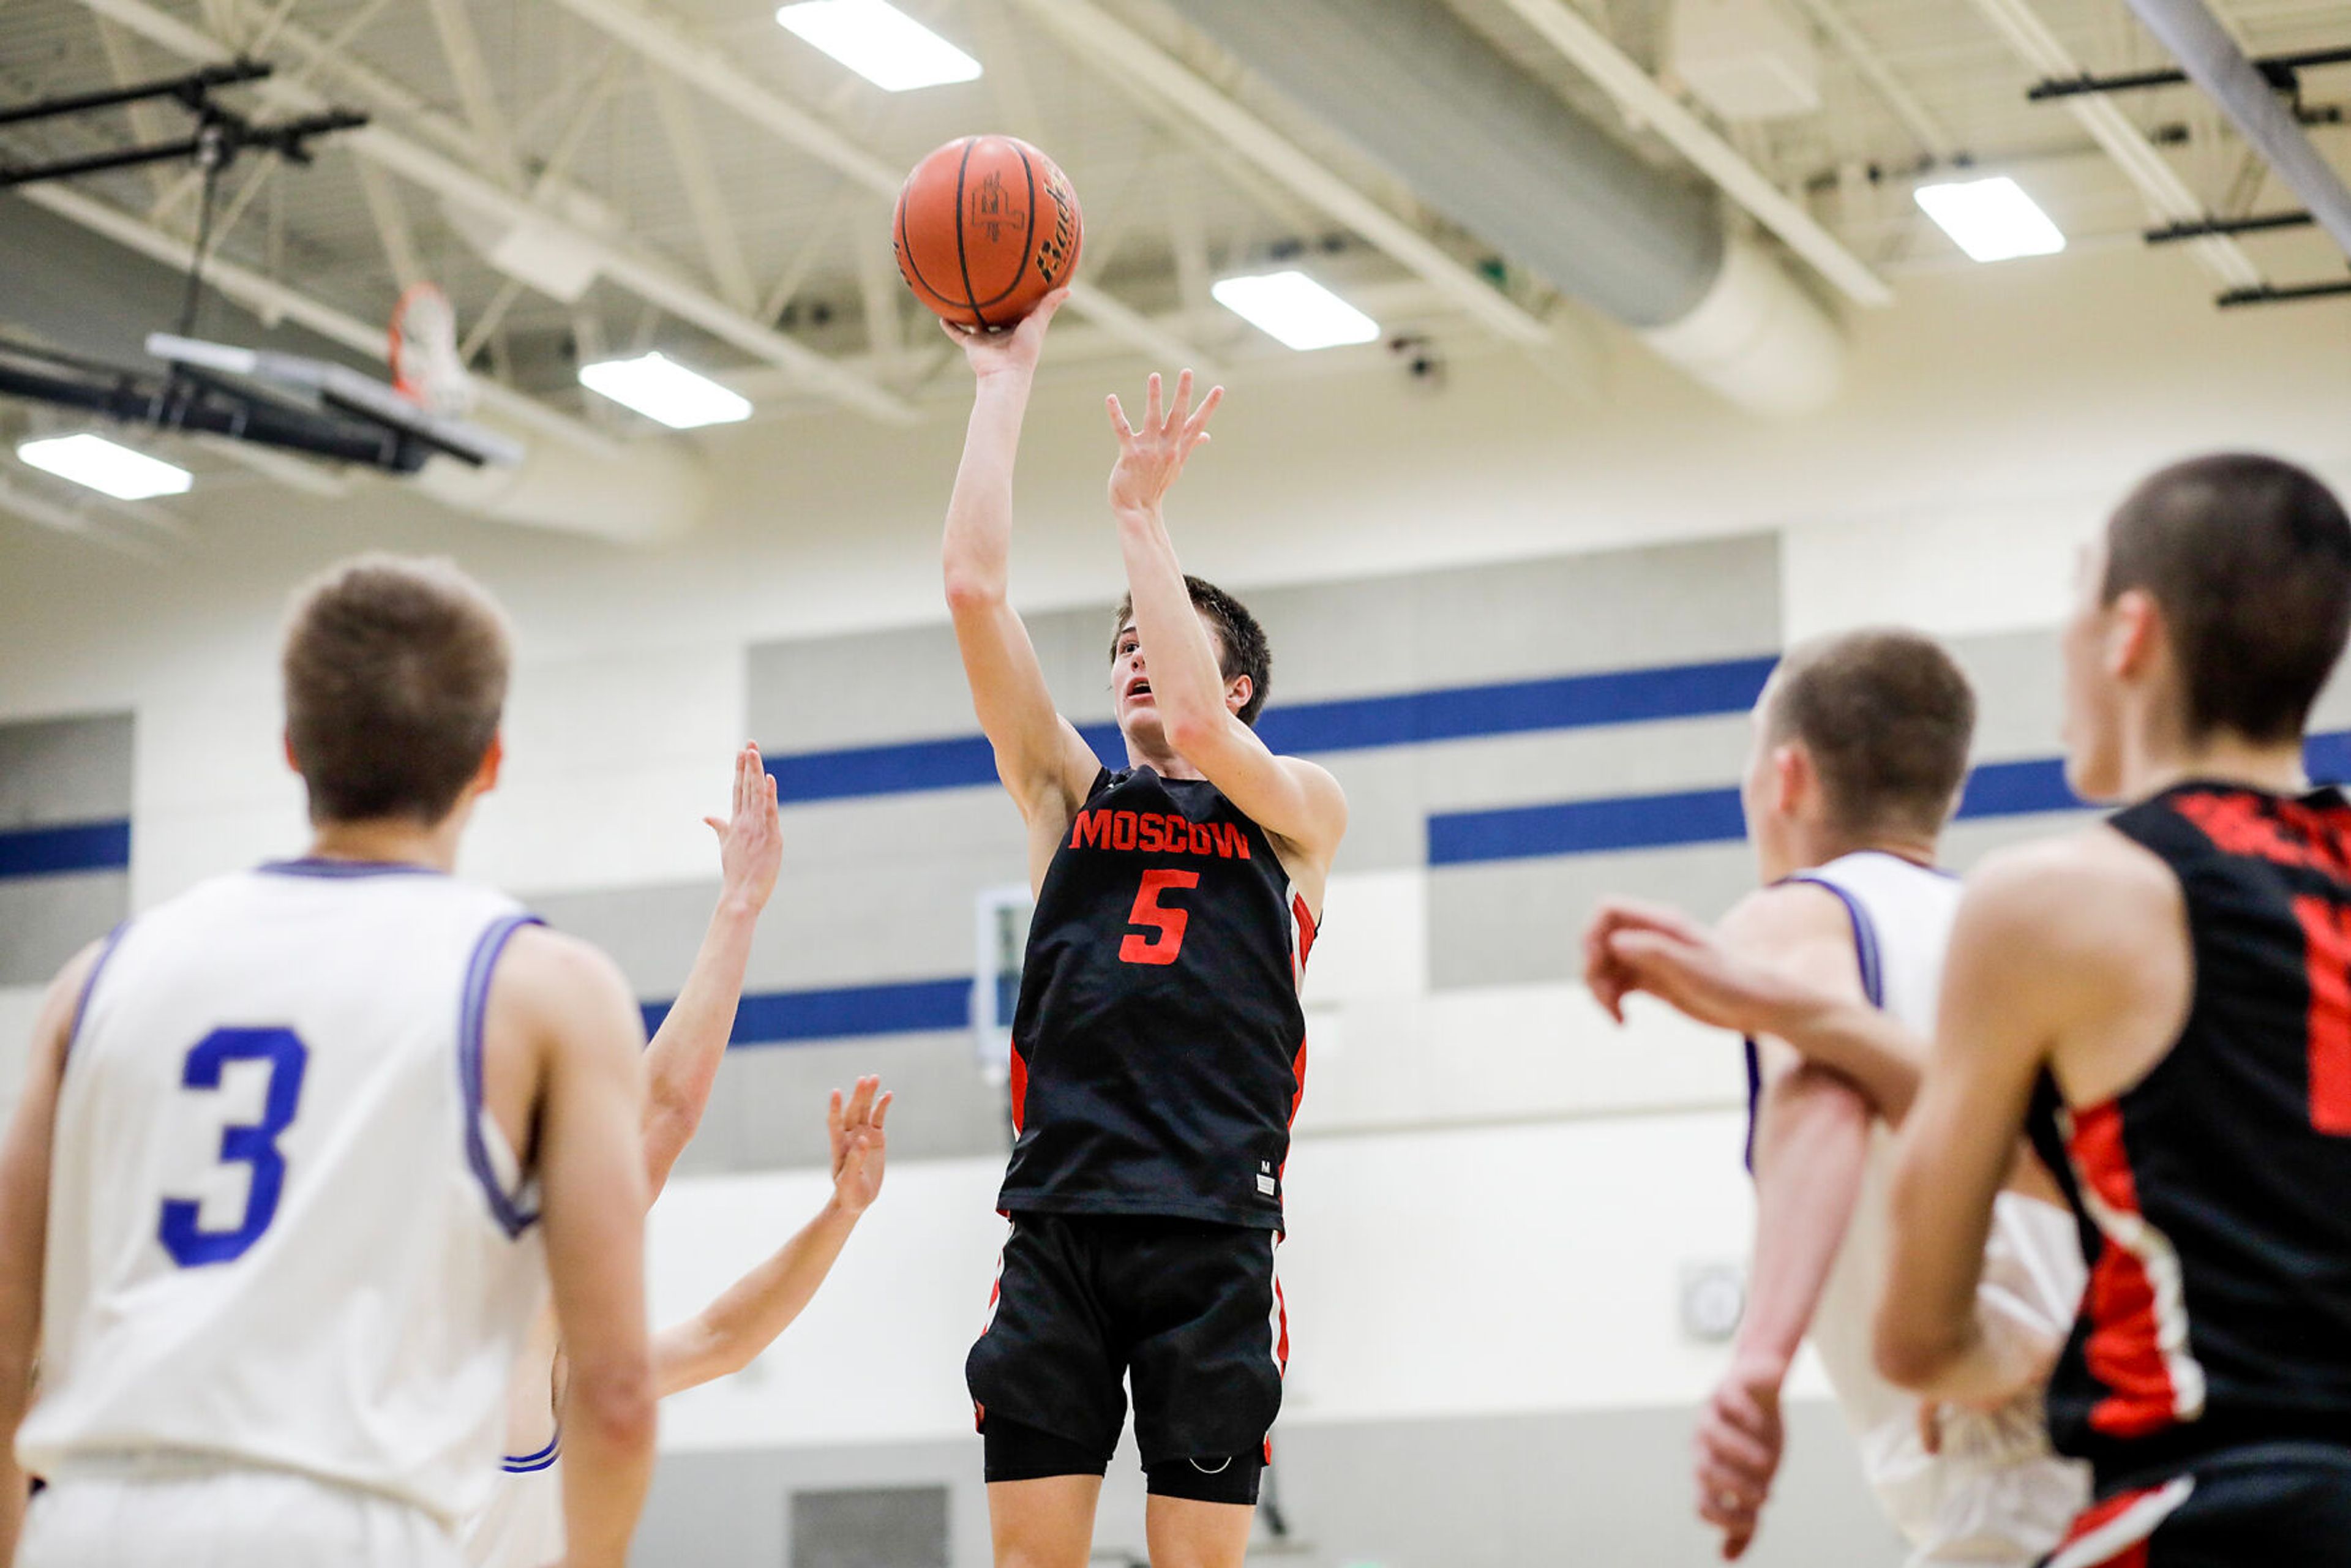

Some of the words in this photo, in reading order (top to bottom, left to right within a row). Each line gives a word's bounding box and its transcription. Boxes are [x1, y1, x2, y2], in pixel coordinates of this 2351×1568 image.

[1068, 809, 1251, 860] MOSCOW
[1118, 868, 1201, 966] 5
[159, 1027, 309, 1269] 3
